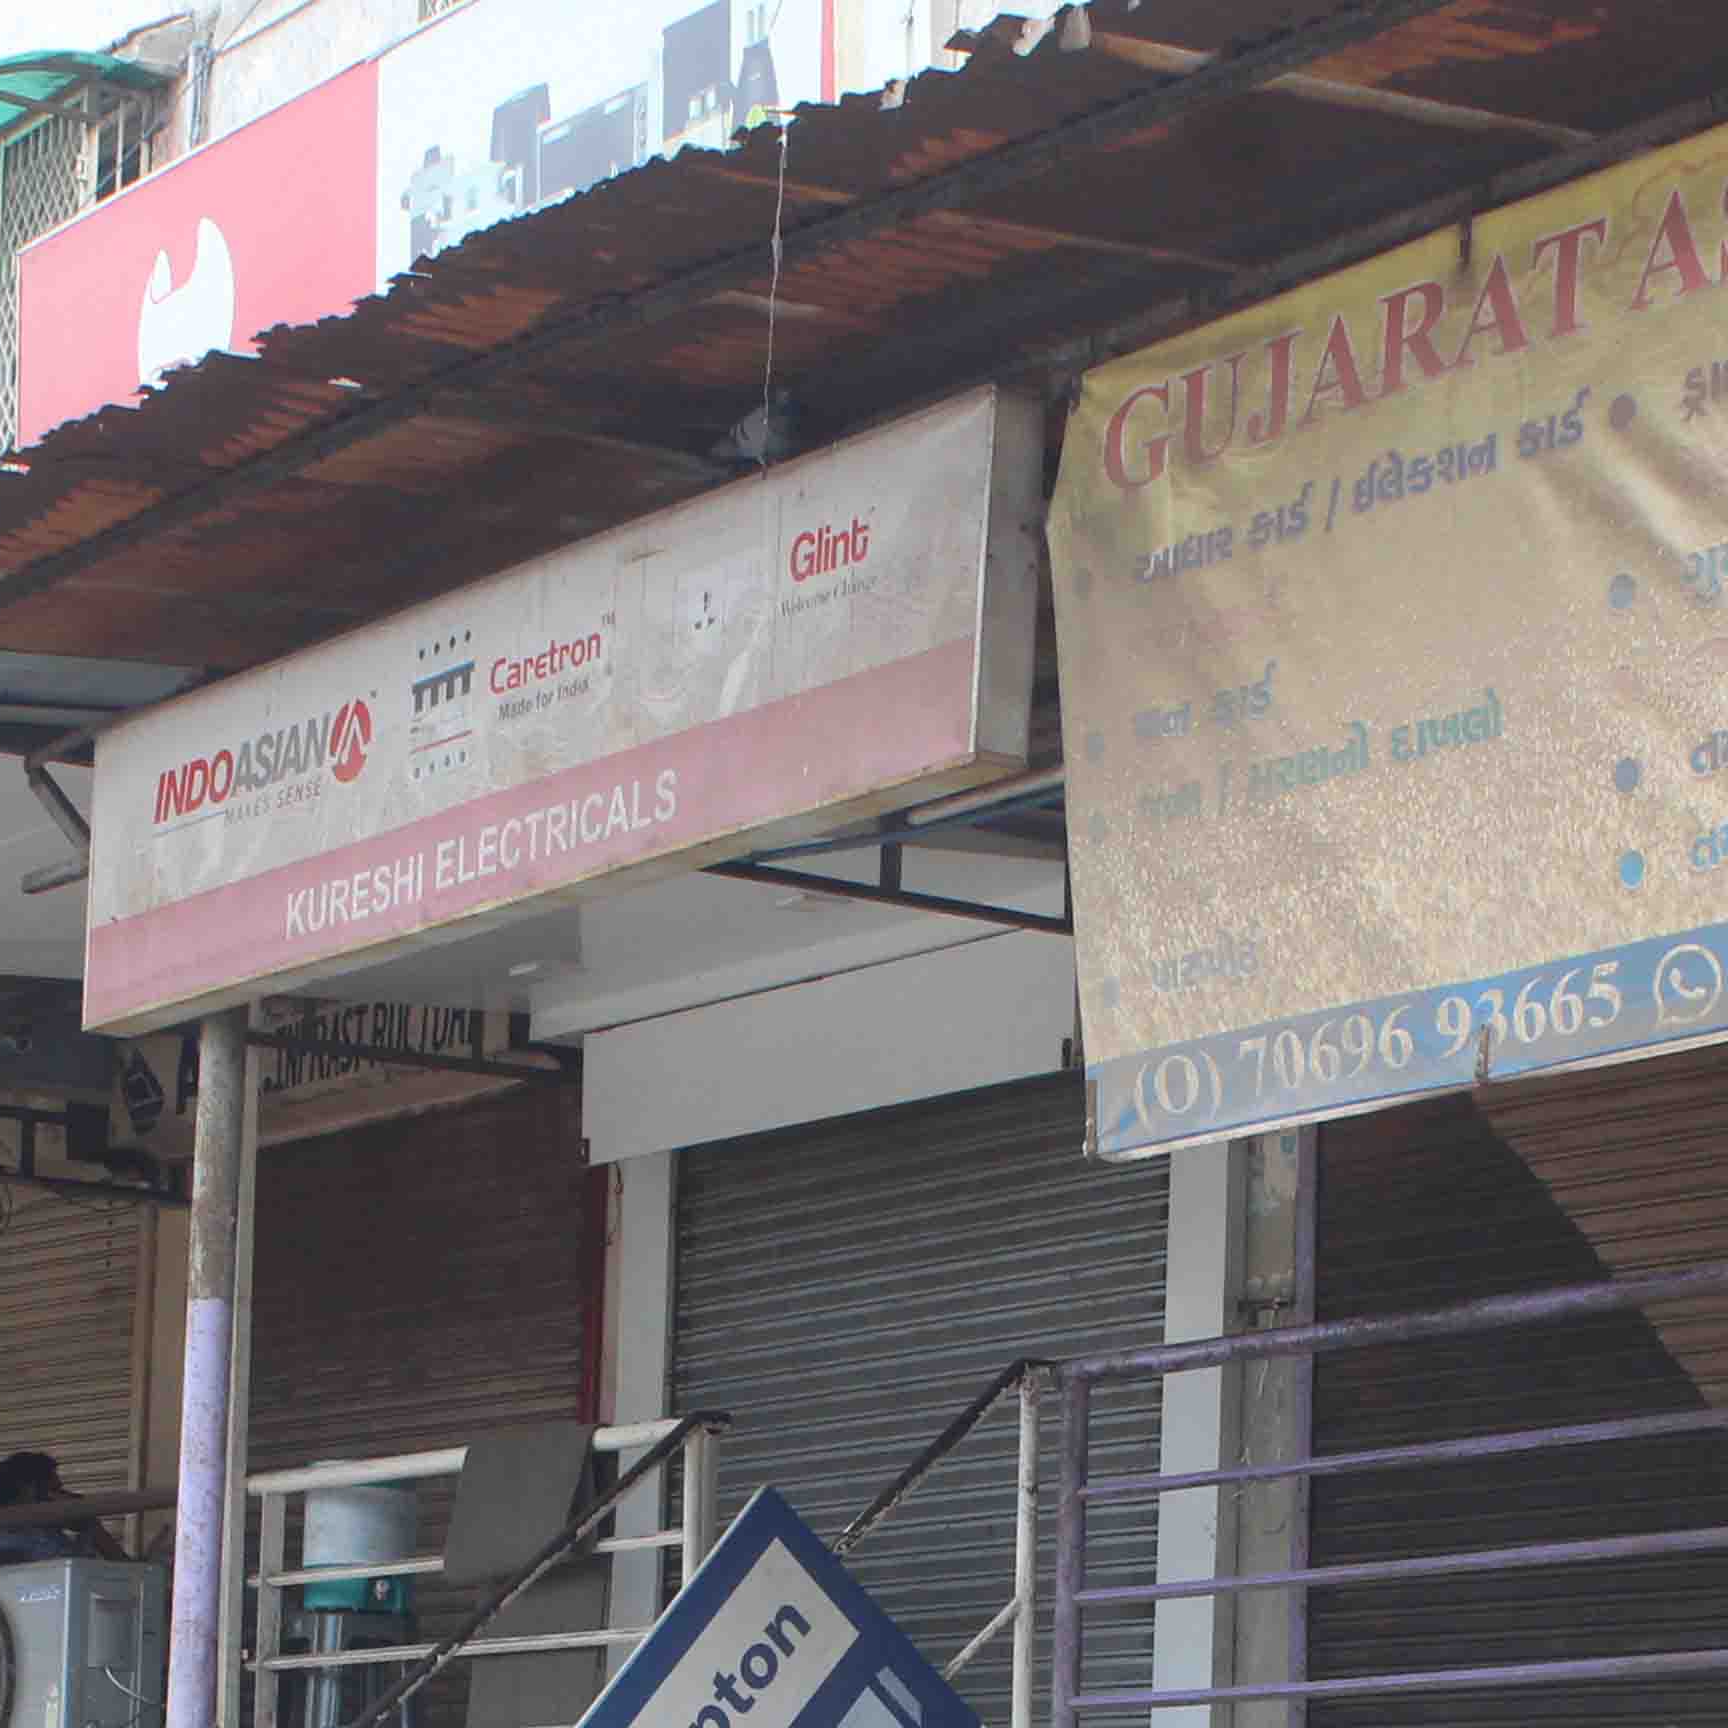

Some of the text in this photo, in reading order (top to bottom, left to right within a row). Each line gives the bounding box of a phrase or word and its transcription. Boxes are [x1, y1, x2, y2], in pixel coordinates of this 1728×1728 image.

[1103, 217, 1607, 491] GUJARAT
[790, 516, 870, 582] Glint
[489, 632, 601, 694] Caretron
[285, 769, 679, 940] KURESHI ELECTRICALS
[1239, 1005, 1414, 1096] 70696
[1435, 960, 1623, 1059] 93665
